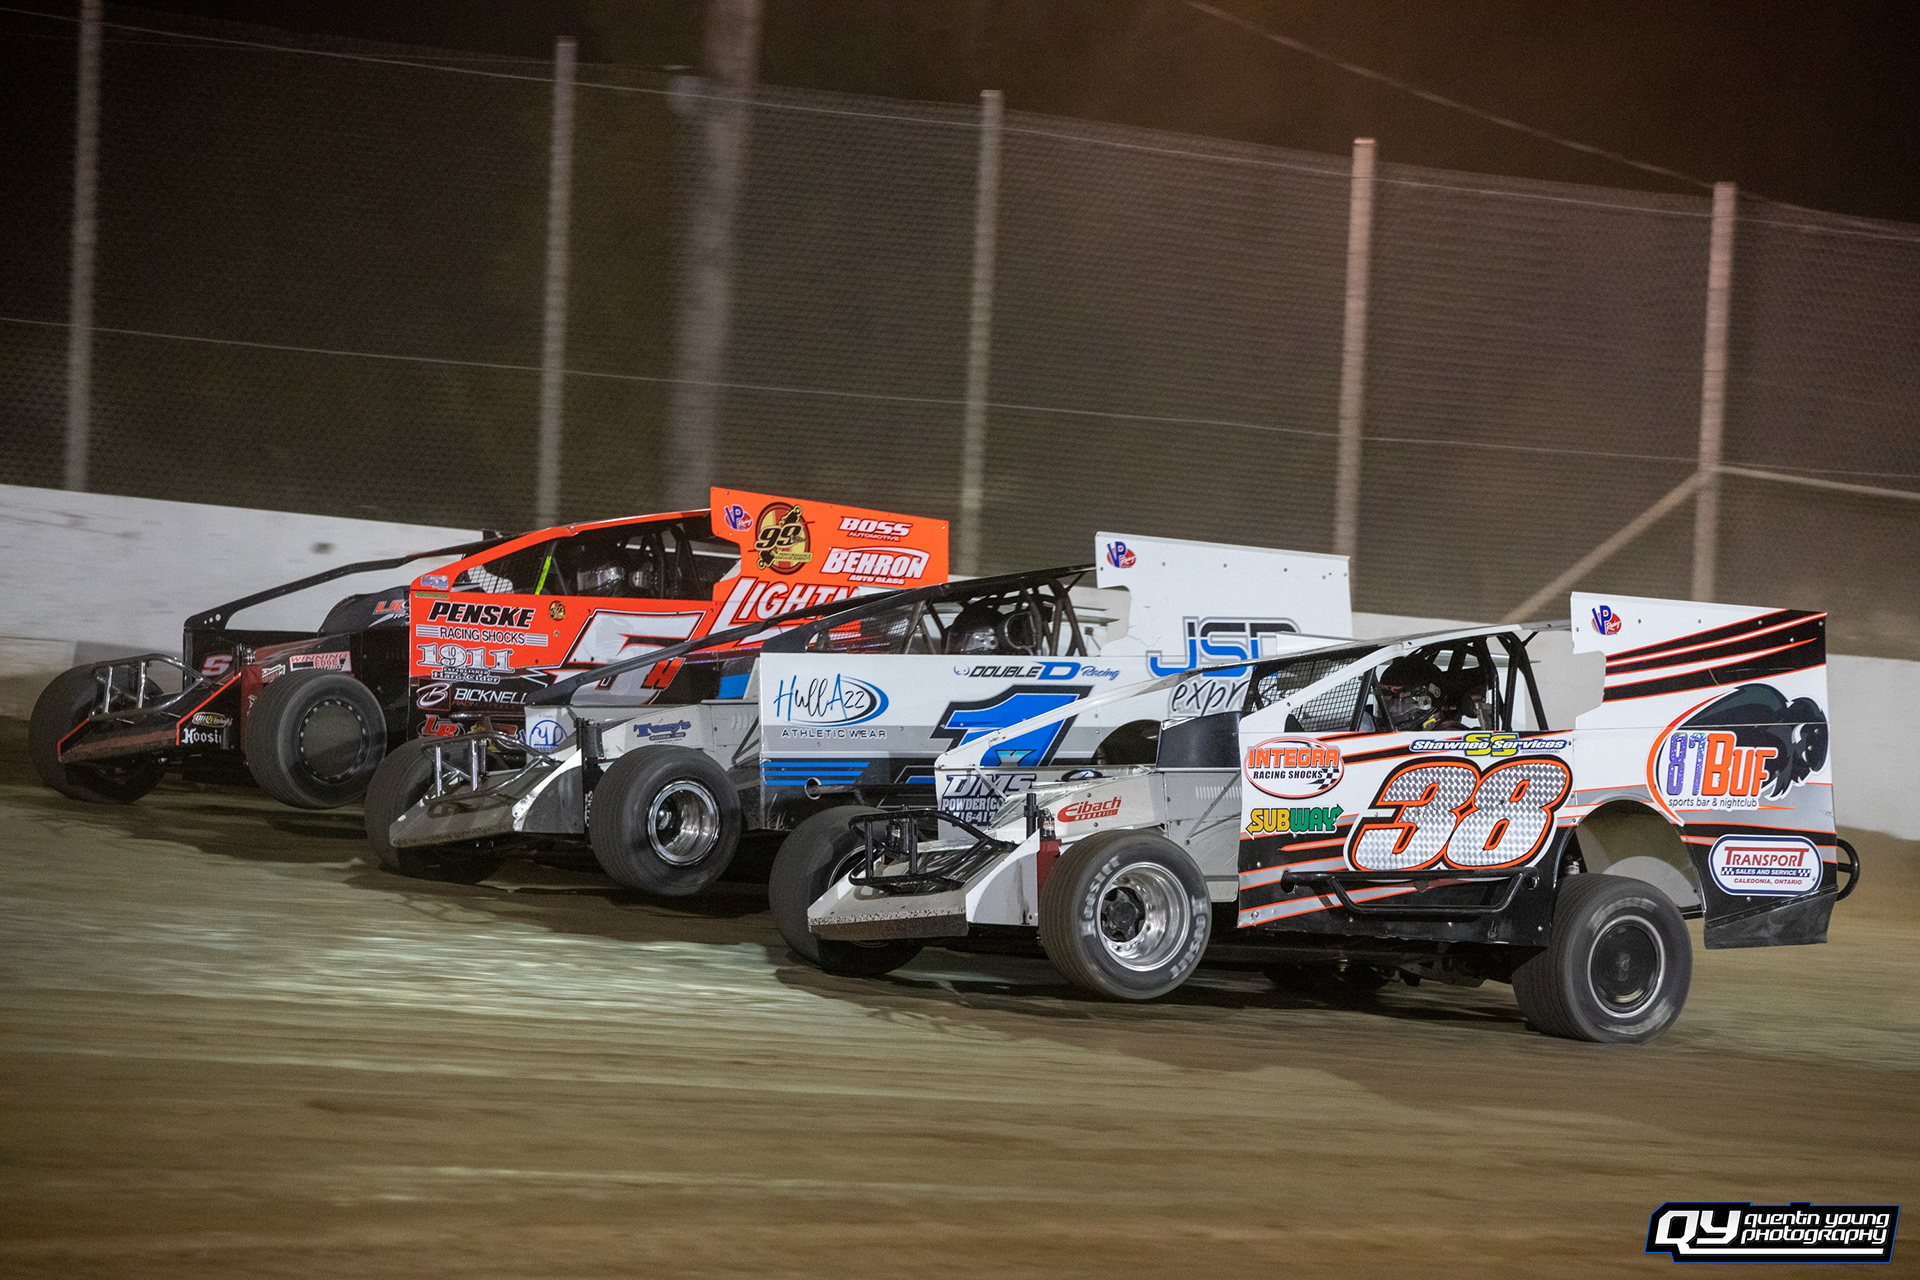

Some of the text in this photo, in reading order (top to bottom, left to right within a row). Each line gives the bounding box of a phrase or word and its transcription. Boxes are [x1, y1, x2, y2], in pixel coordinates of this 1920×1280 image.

[725, 505, 744, 530] VP
[839, 517, 912, 537] BOSS
[755, 523, 803, 550] 99
[848, 532, 901, 542] AUTOMOTIVE
[821, 547, 929, 578] BEHRON
[1107, 541, 1127, 568] VP
[875, 576, 905, 585] GLASS
[428, 602, 535, 628] PENSKE
[1591, 605, 1611, 635] VP
[440, 627, 525, 644] RACING SHOCKS
[290, 652, 348, 662] WINNING
[315, 659, 338, 668] EDGE
[417, 643, 515, 673] 1911
[432, 670, 500, 685] Hard Cider
[968, 666, 1043, 678] DOUBLE
[1080, 666, 1121, 681] Racing
[1171, 678, 1250, 717] expr
[781, 729, 887, 739] ATHLETIC WEAR
[1411, 740, 1566, 750] Shawnee Services
[1248, 748, 1339, 768] INTEGRA
[1253, 770, 1324, 779] RACING SHOCKS
[942, 773, 1037, 799] DMS
[942, 798, 986, 811] POWDER
[1057, 796, 1122, 823] Eibach
[1668, 797, 1758, 809] sports bar & nightclub
[1246, 804, 1344, 838] SUBWAY
[1350, 759, 1571, 871] 38
[1724, 847, 1810, 867] TRANSPORT
